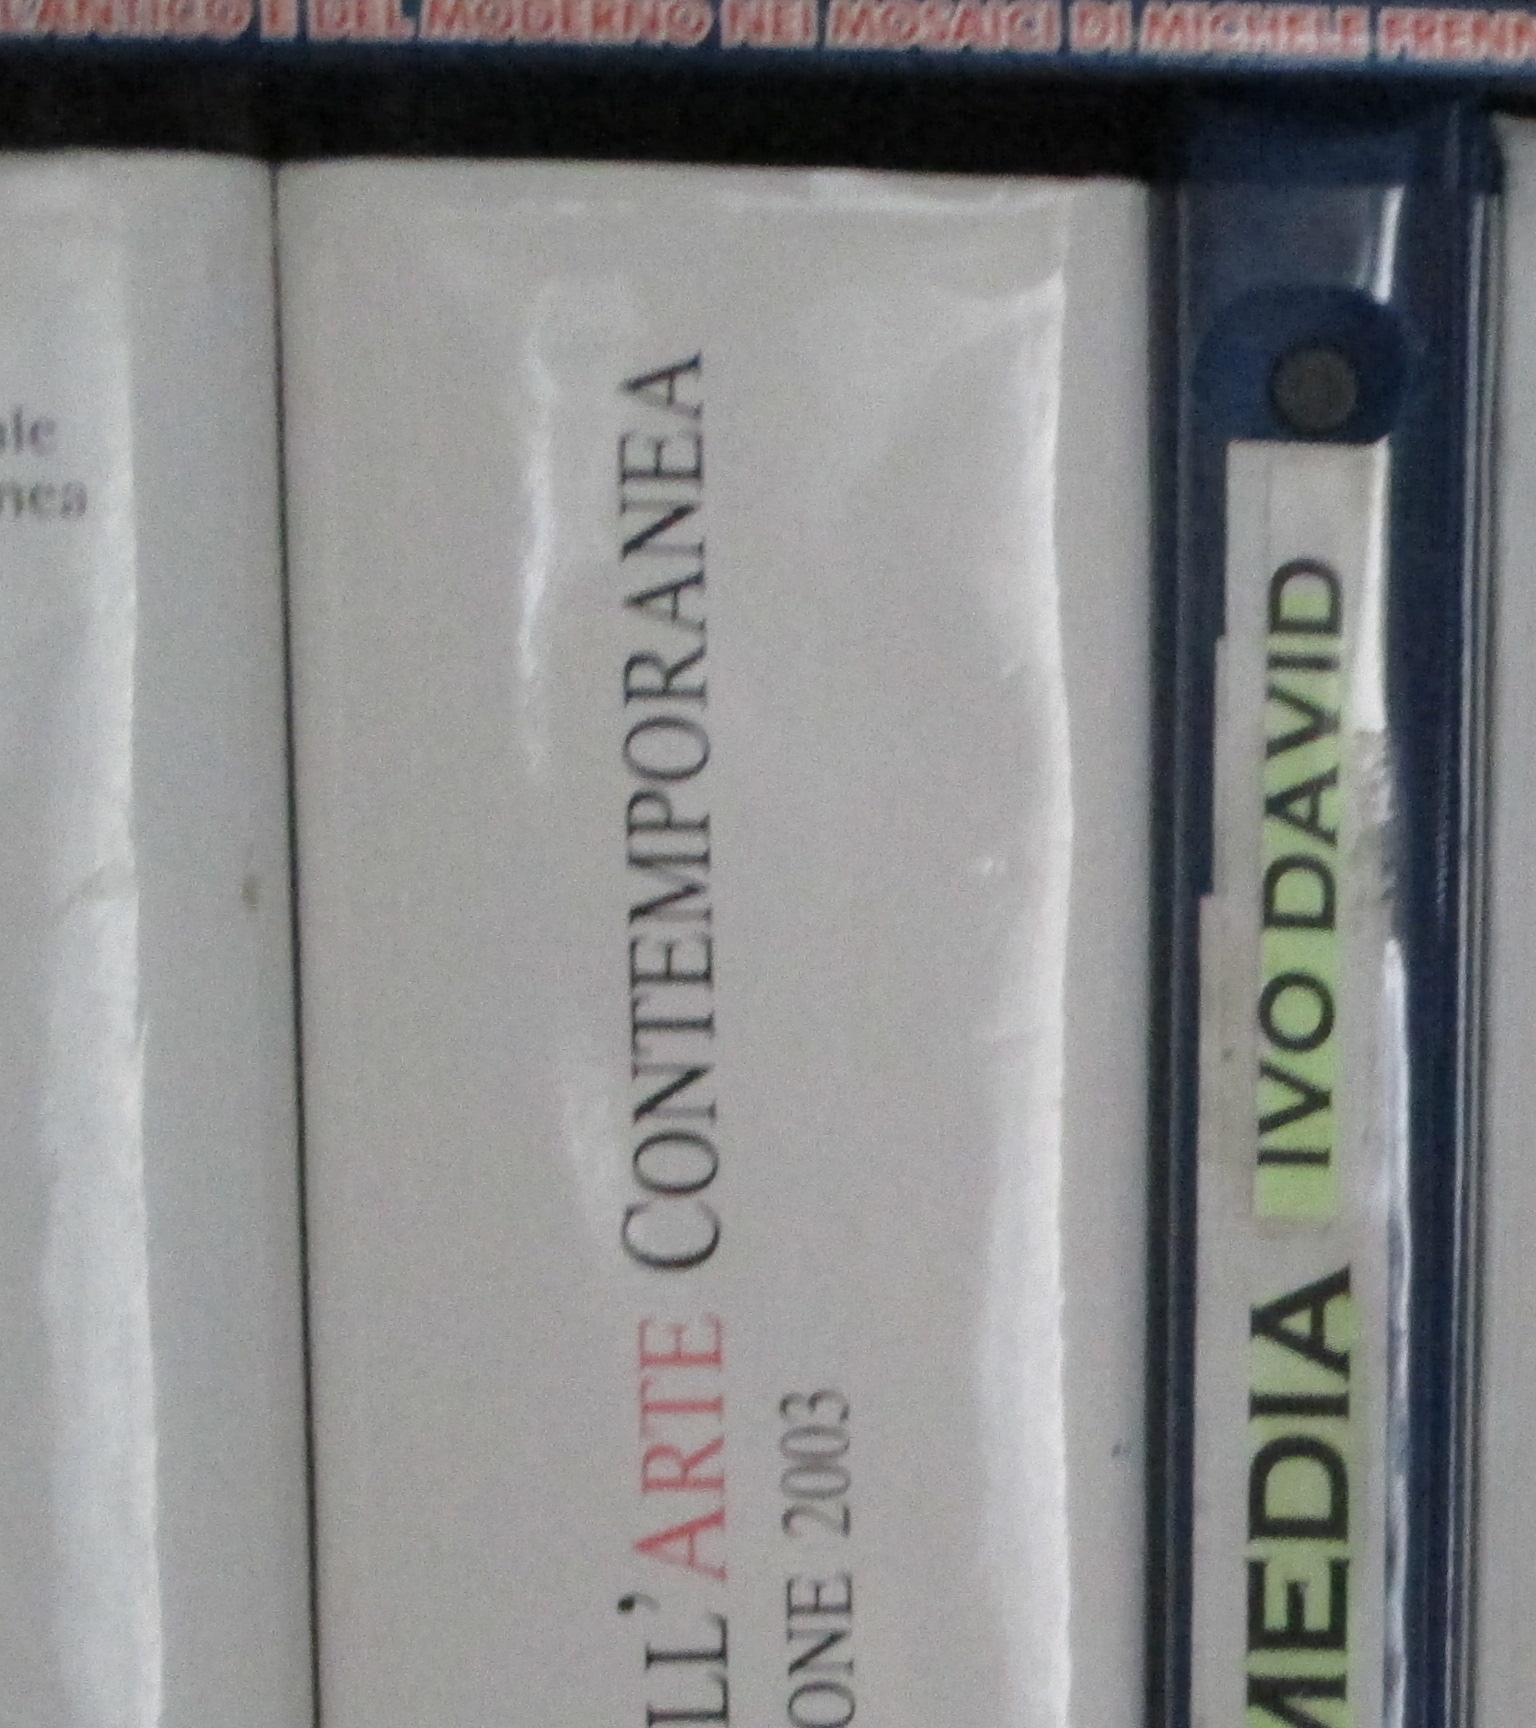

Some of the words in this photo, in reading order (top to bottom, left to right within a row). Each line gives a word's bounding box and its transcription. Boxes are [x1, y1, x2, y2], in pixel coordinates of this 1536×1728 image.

[618, 353, 722, 1273] CONTEMPORANEA
[1259, 557, 1342, 932] DAVID
[1255, 971, 1336, 1168] IVO
[777, 1389, 852, 1538] 2003
